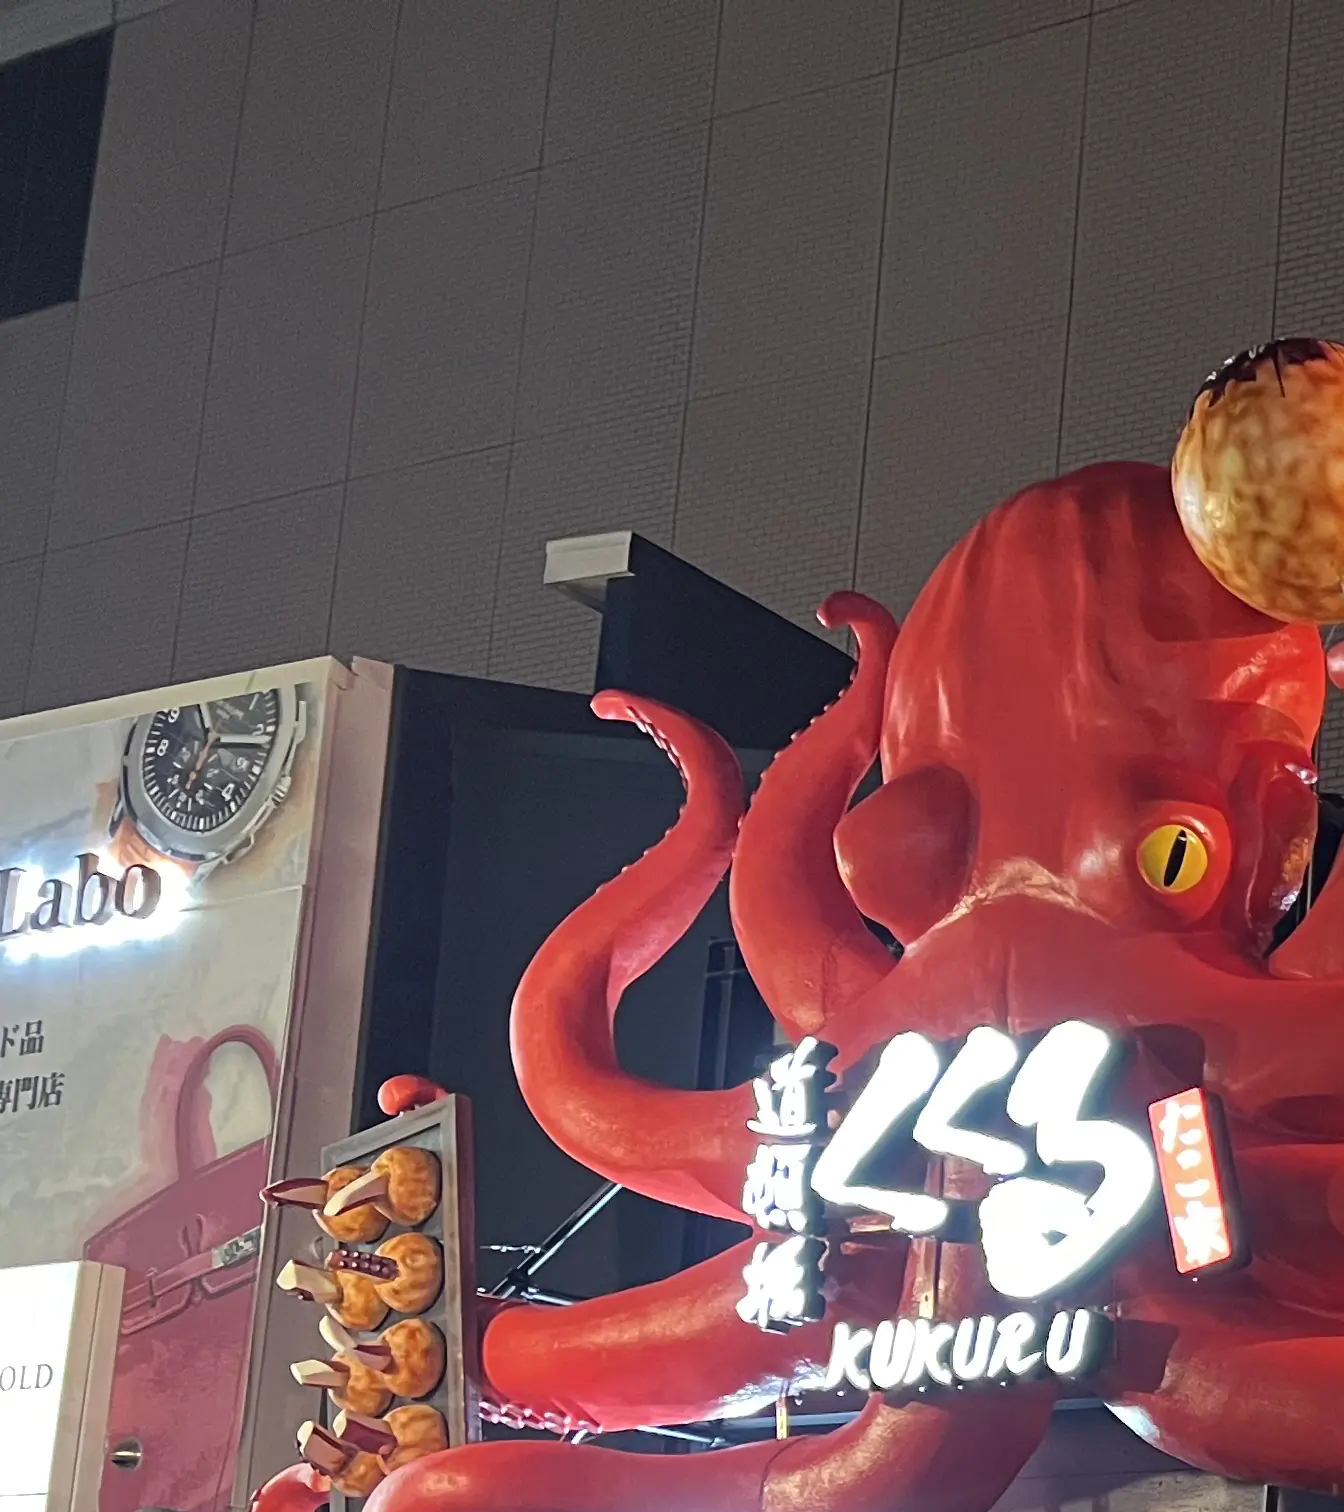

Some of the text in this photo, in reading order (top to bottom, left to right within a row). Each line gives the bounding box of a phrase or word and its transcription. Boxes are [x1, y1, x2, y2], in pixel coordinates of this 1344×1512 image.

[810, 1017, 1156, 1300] くくる
[823, 1308, 1092, 1391] KUKURU
